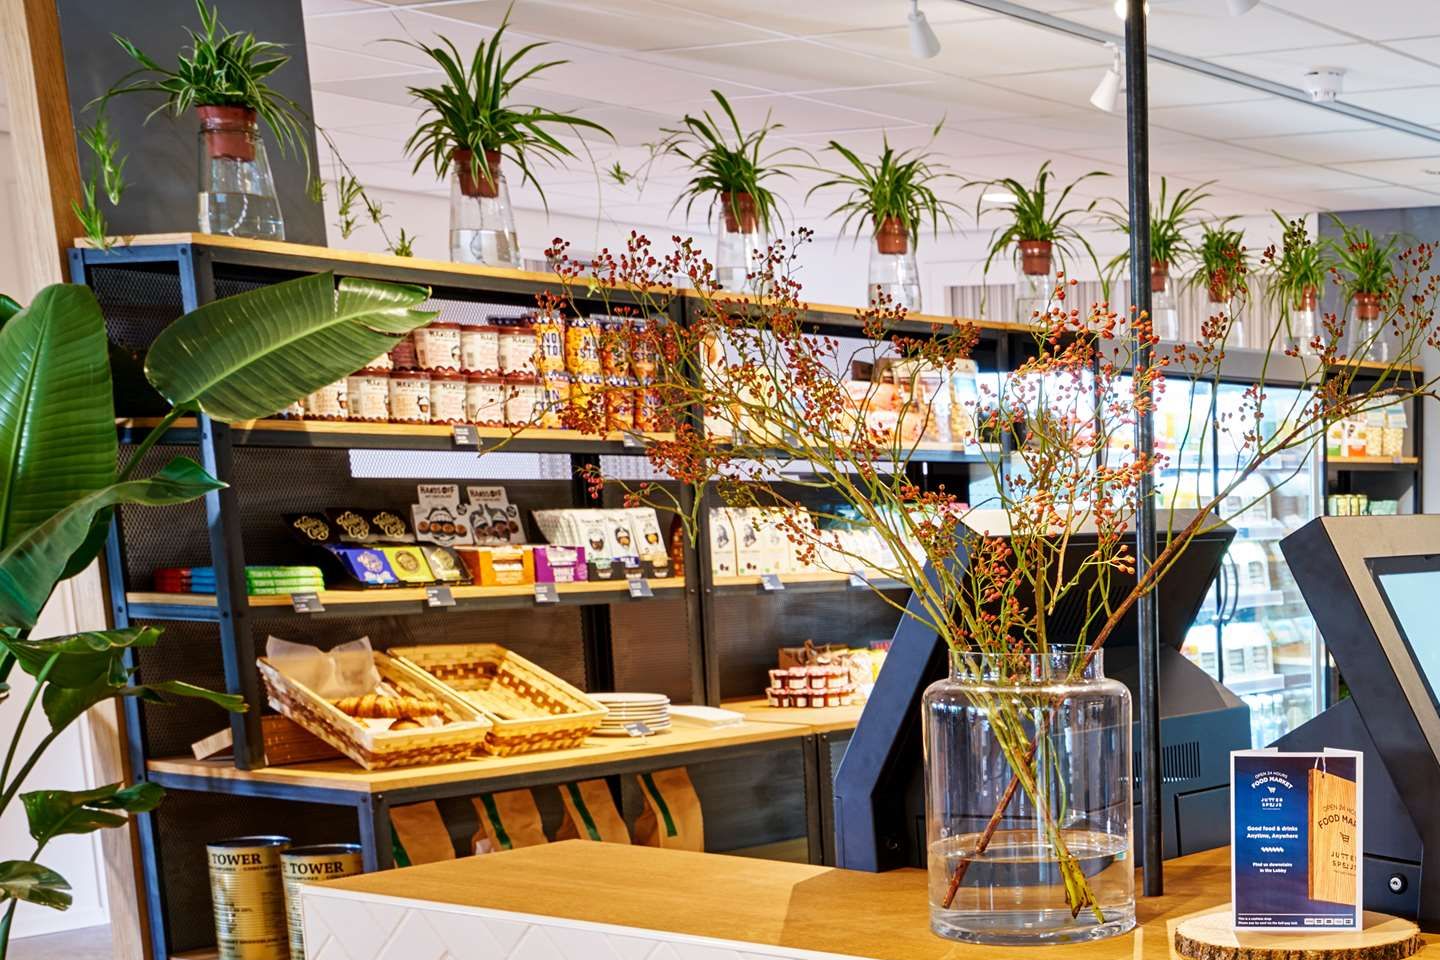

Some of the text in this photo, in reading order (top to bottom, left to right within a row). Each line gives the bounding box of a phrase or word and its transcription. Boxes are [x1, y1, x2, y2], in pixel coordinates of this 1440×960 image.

[1251, 776, 1294, 790] FOOD MARKET
[1318, 814, 1340, 829] FOOD
[212, 854, 262, 866] TOWER
[1331, 851, 1356, 862] JUTTE
[290, 861, 344, 874] TOWER
